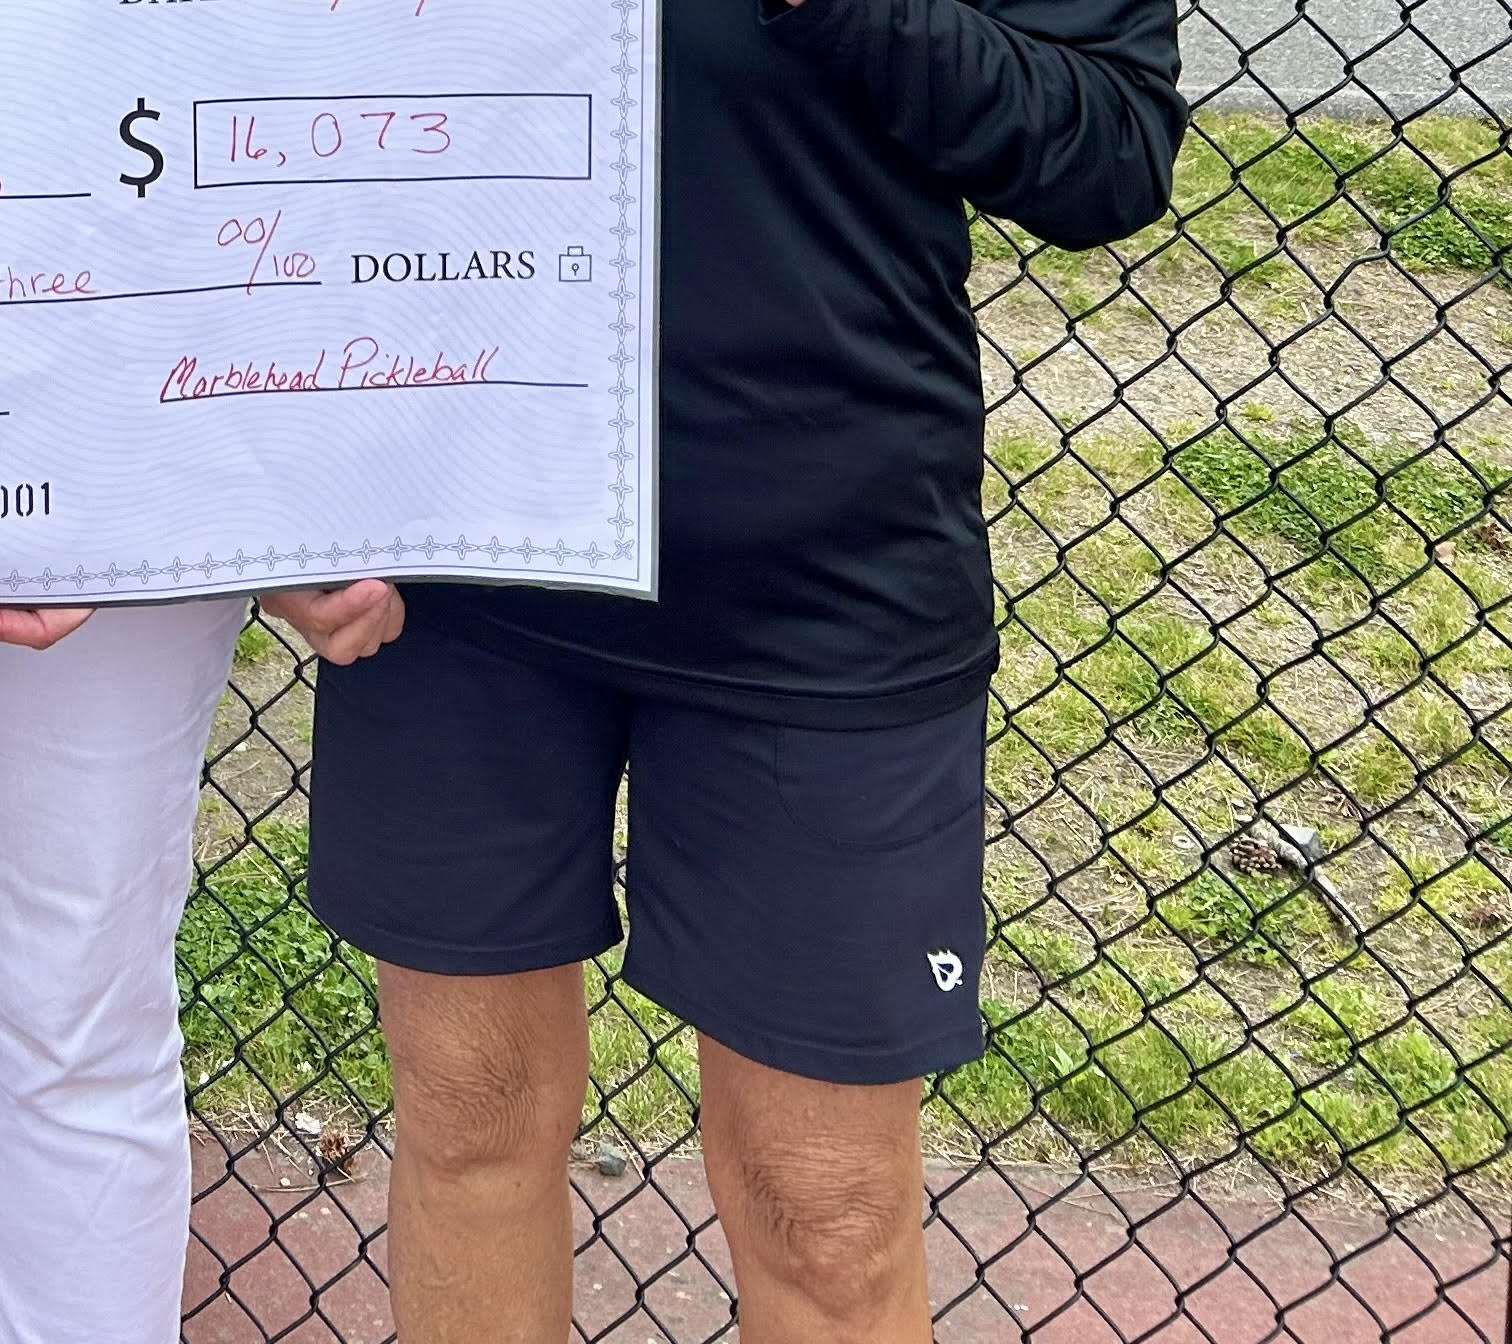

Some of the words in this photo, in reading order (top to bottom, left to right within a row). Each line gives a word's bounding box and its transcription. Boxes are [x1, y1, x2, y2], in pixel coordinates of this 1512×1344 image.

[119, 97, 164, 198] $
[230, 112, 451, 166] 16,073
[351, 251, 536, 284] DOLLARS
[160, 349, 325, 402] Marblehead
[338, 337, 499, 389] Pickleball
